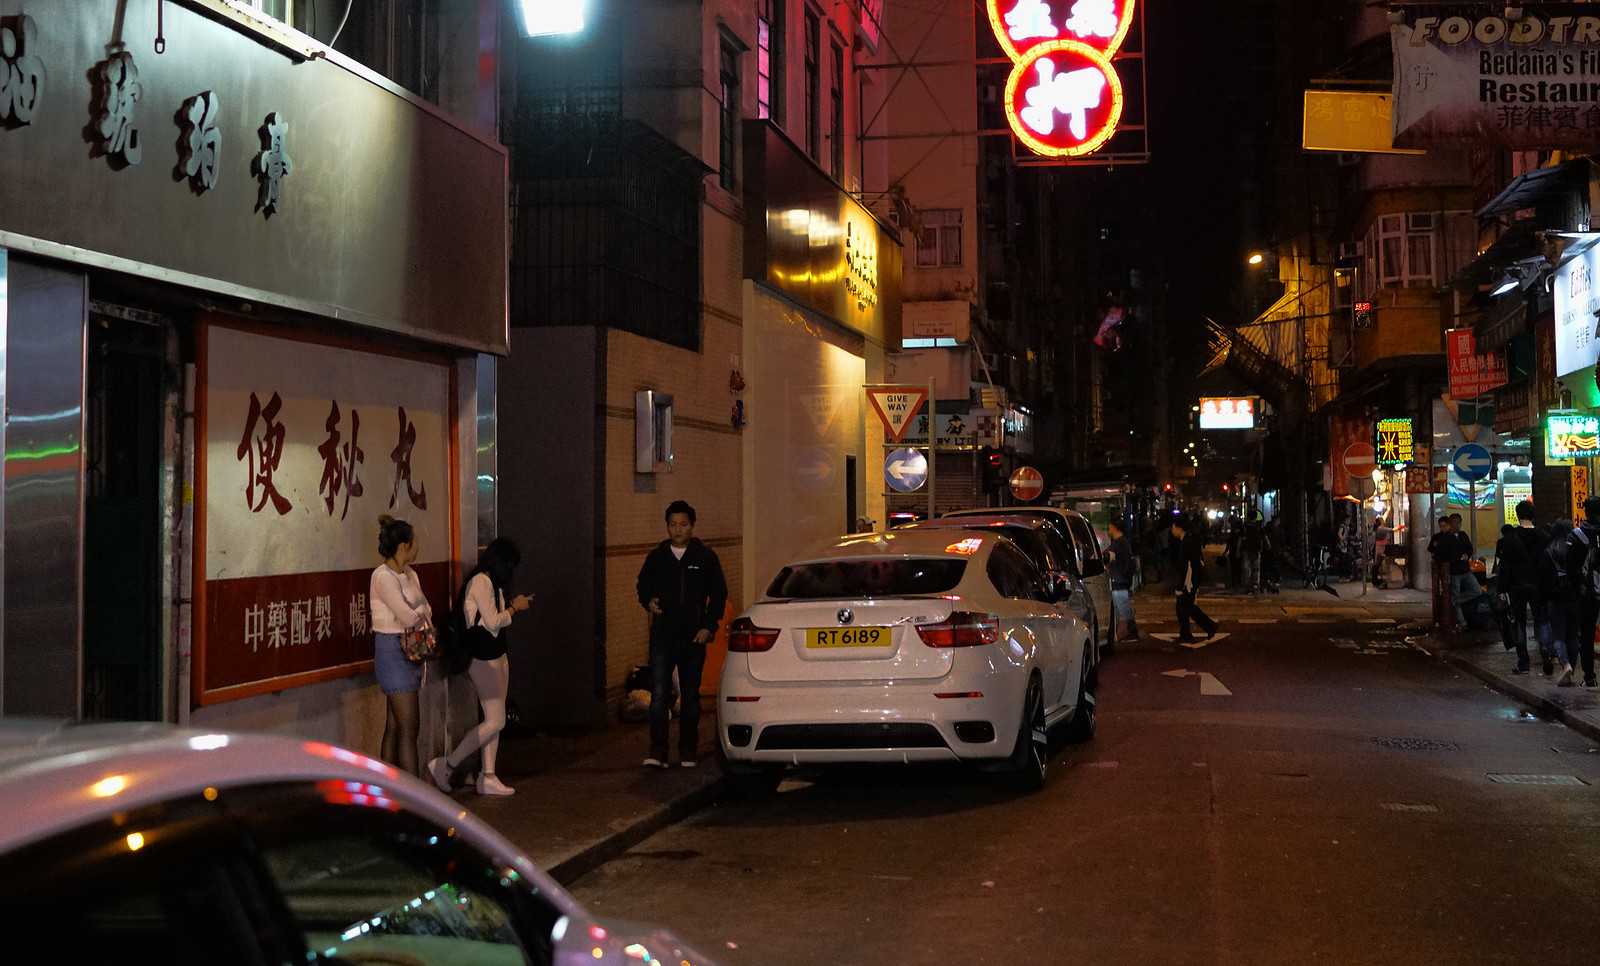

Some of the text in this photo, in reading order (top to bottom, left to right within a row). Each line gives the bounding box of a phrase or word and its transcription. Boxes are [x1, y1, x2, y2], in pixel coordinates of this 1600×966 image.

[887, 395, 908, 403] GIVE
[887, 403, 907, 411] WAY
[237, 391, 427, 521] 便秘丸
[244, 593, 373, 652] 中藥配製 暢
[817, 629, 880, 644] RT 6189
